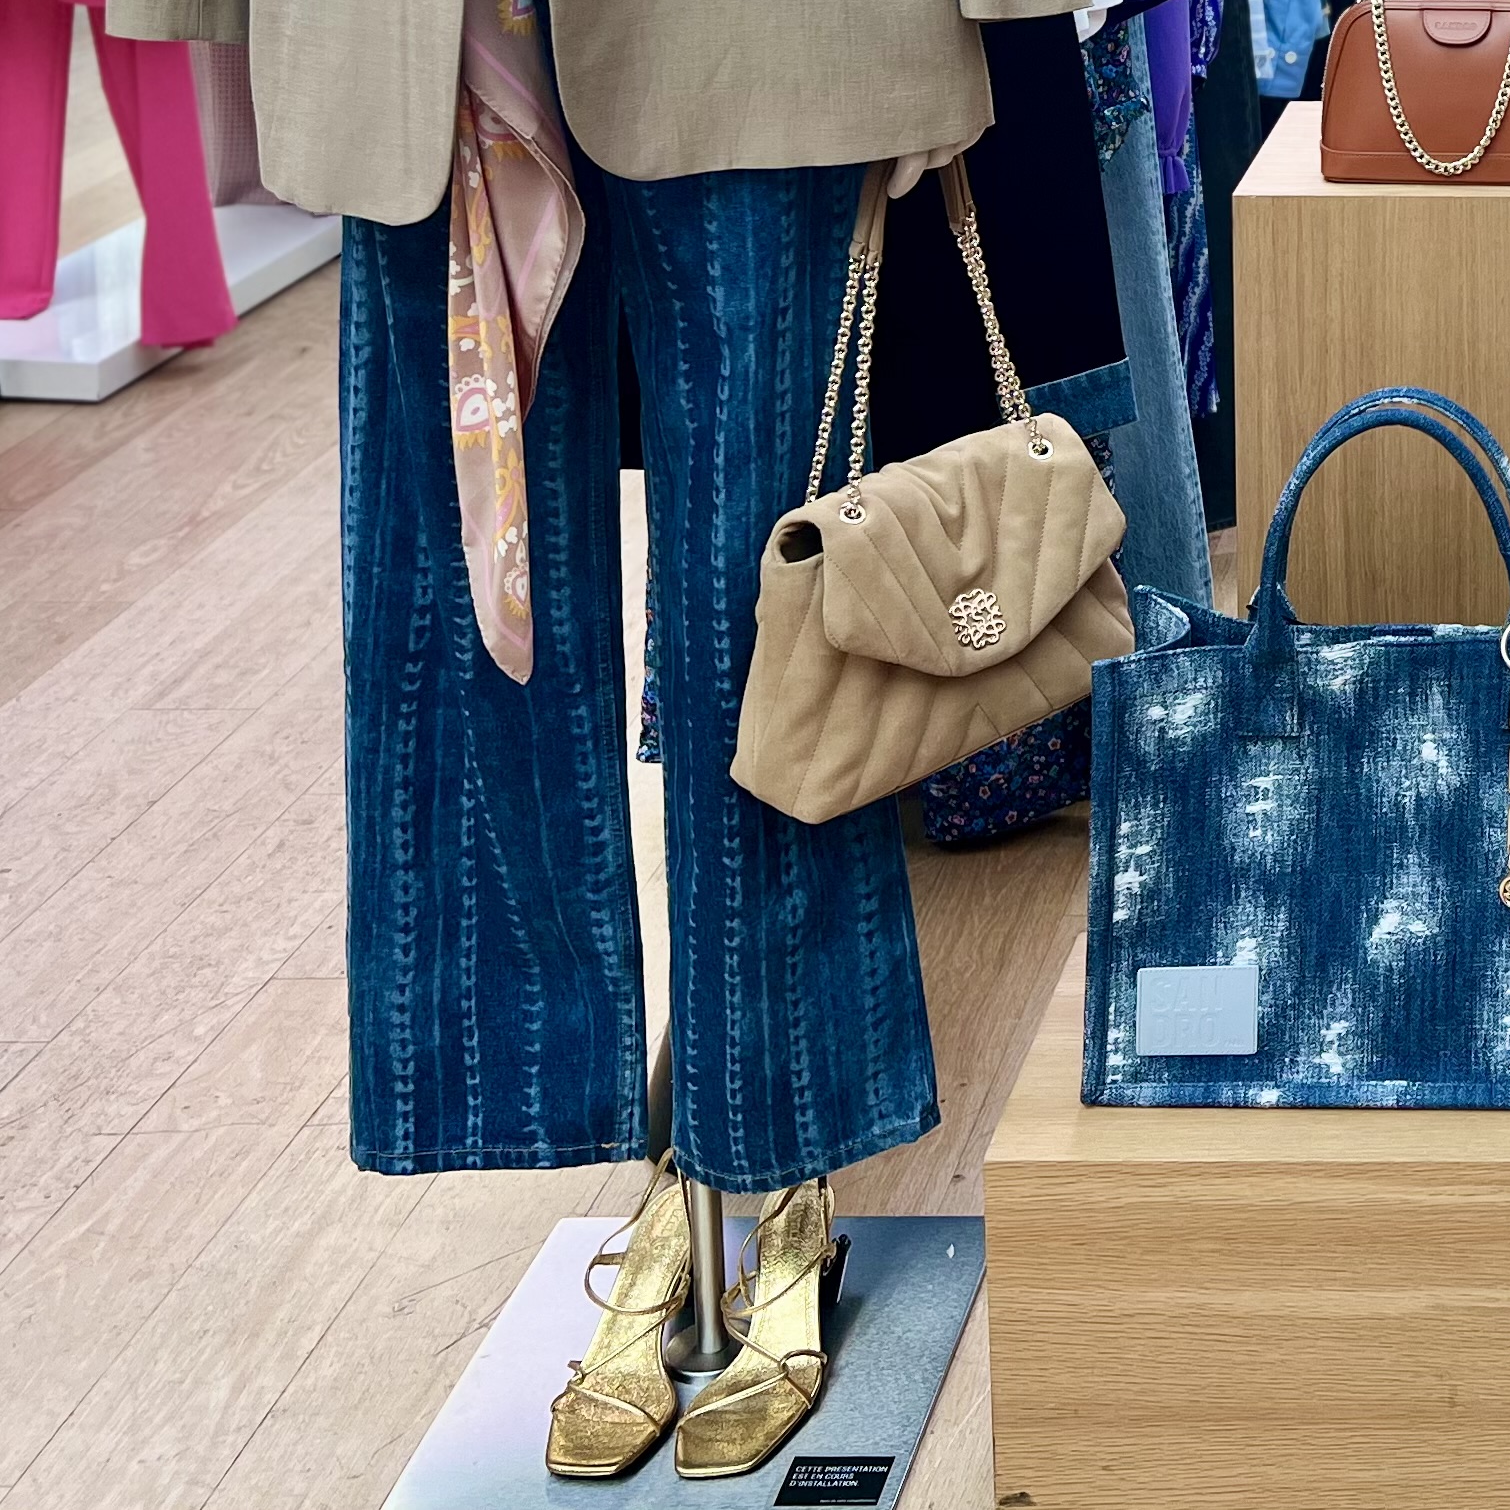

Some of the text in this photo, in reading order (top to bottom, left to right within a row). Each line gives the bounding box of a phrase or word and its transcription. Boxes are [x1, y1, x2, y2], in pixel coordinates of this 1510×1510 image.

[795, 1465, 823, 1473] CETTE
[792, 1472, 855, 1480] EST EN COURS
